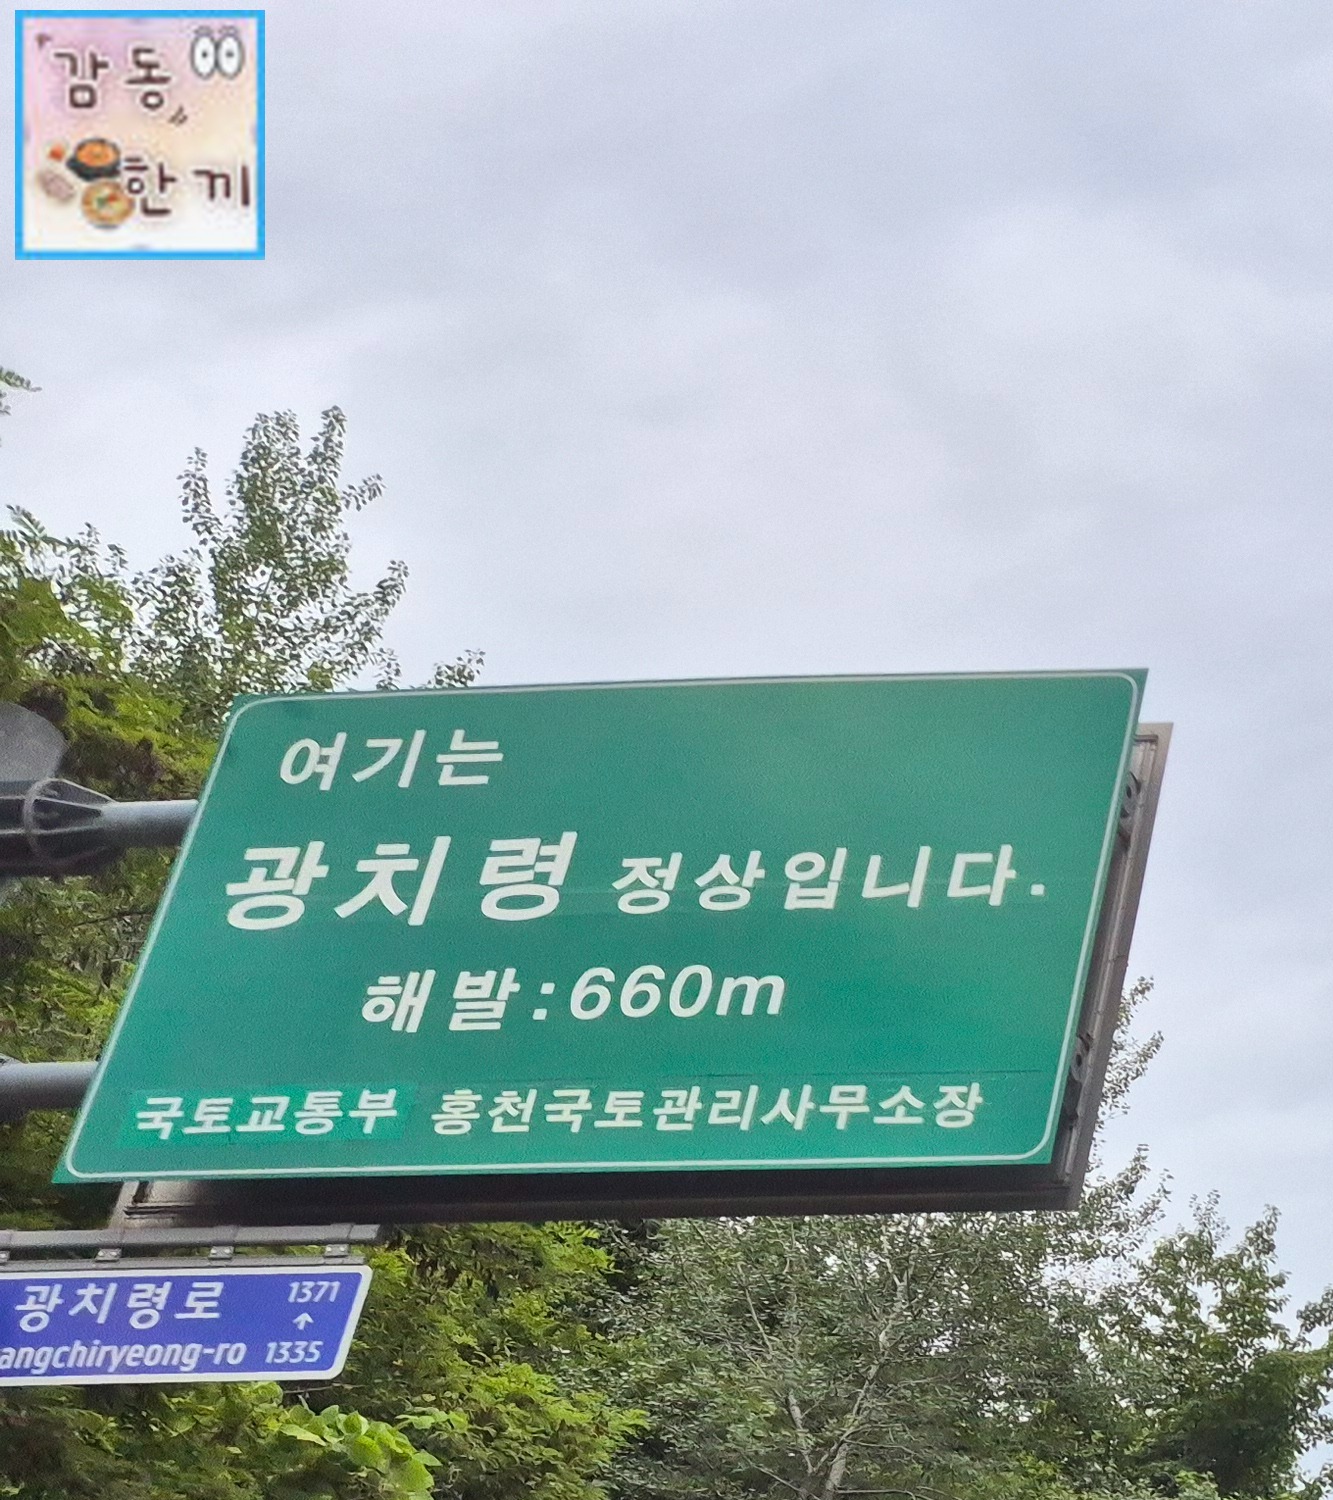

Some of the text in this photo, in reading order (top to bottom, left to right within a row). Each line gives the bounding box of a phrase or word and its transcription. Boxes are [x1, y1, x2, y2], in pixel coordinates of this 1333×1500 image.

[279, 728, 505, 791] 여기는
[226, 831, 1046, 931] 광치령 정상입니다.
[135, 1082, 983, 1136] 국토교통부 홍천국토관리사무소장
[15, 1281, 224, 1333] 광치령로
[288, 1281, 341, 1303] 1371
[0, 1339, 247, 1375] angchiryeong-ro
[265, 1340, 323, 1364] 1335
